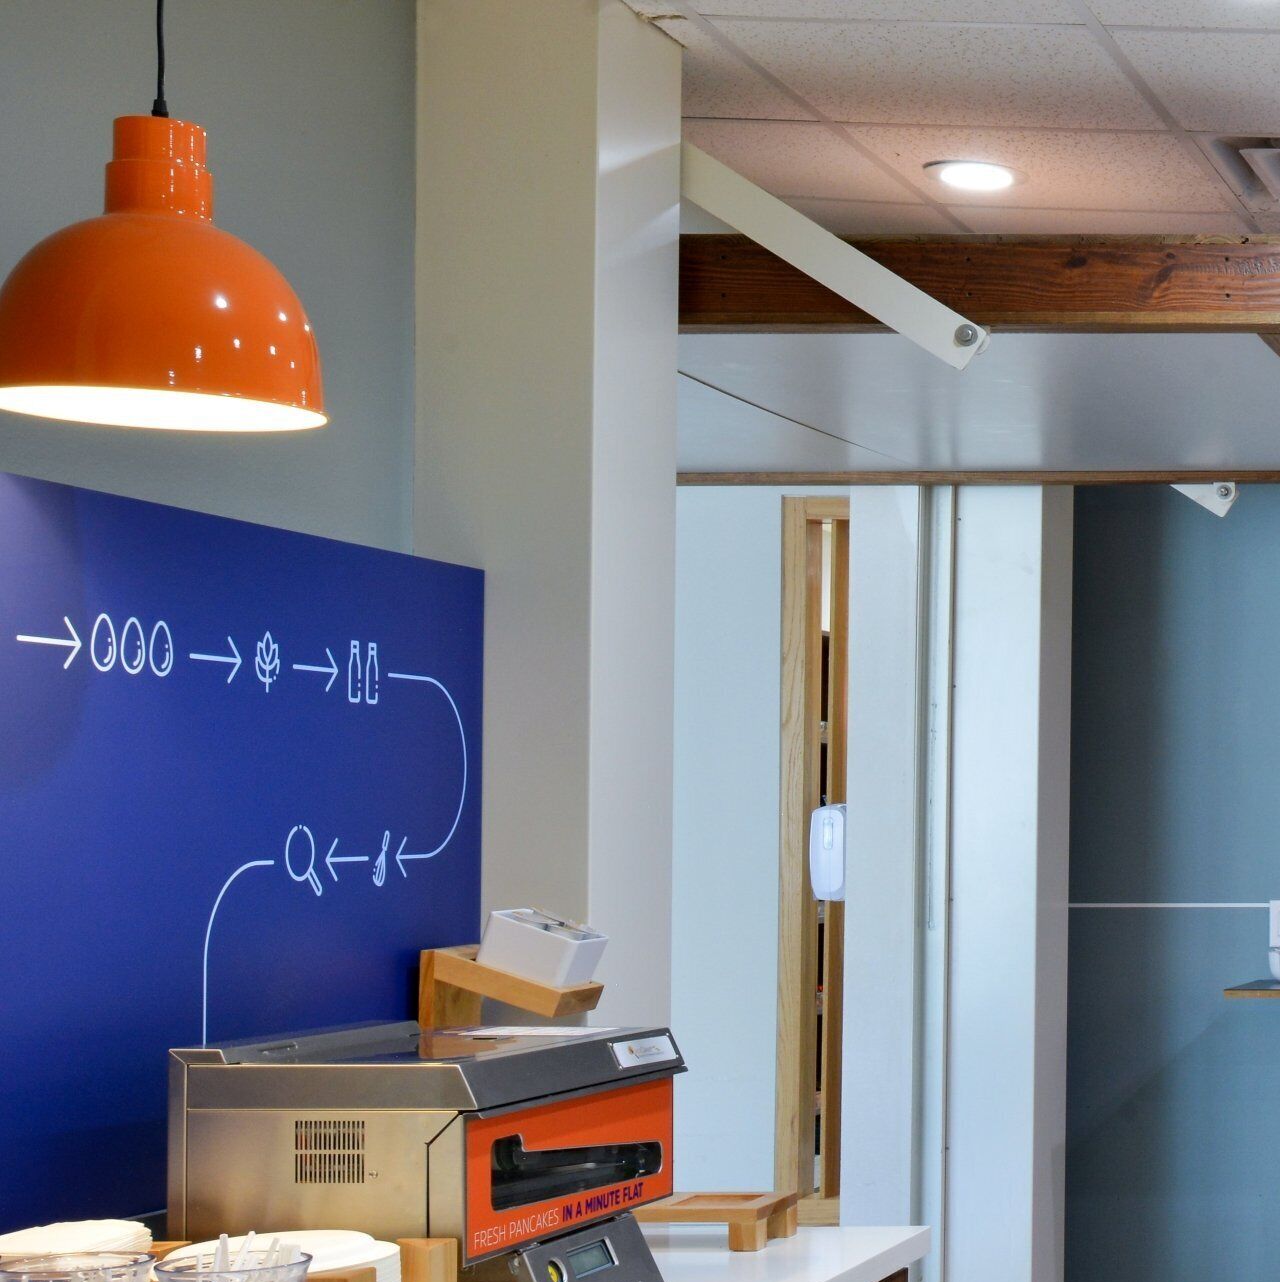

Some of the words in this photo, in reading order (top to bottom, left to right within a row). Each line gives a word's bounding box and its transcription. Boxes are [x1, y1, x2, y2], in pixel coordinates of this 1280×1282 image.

[474, 1224, 507, 1250] FRESH
[509, 1207, 560, 1241] PANCAKES
[562, 1204, 573, 1222] IN
[575, 1202, 583, 1217] A
[585, 1190, 621, 1216] MINUTE
[622, 1182, 644, 1201] FLAT
